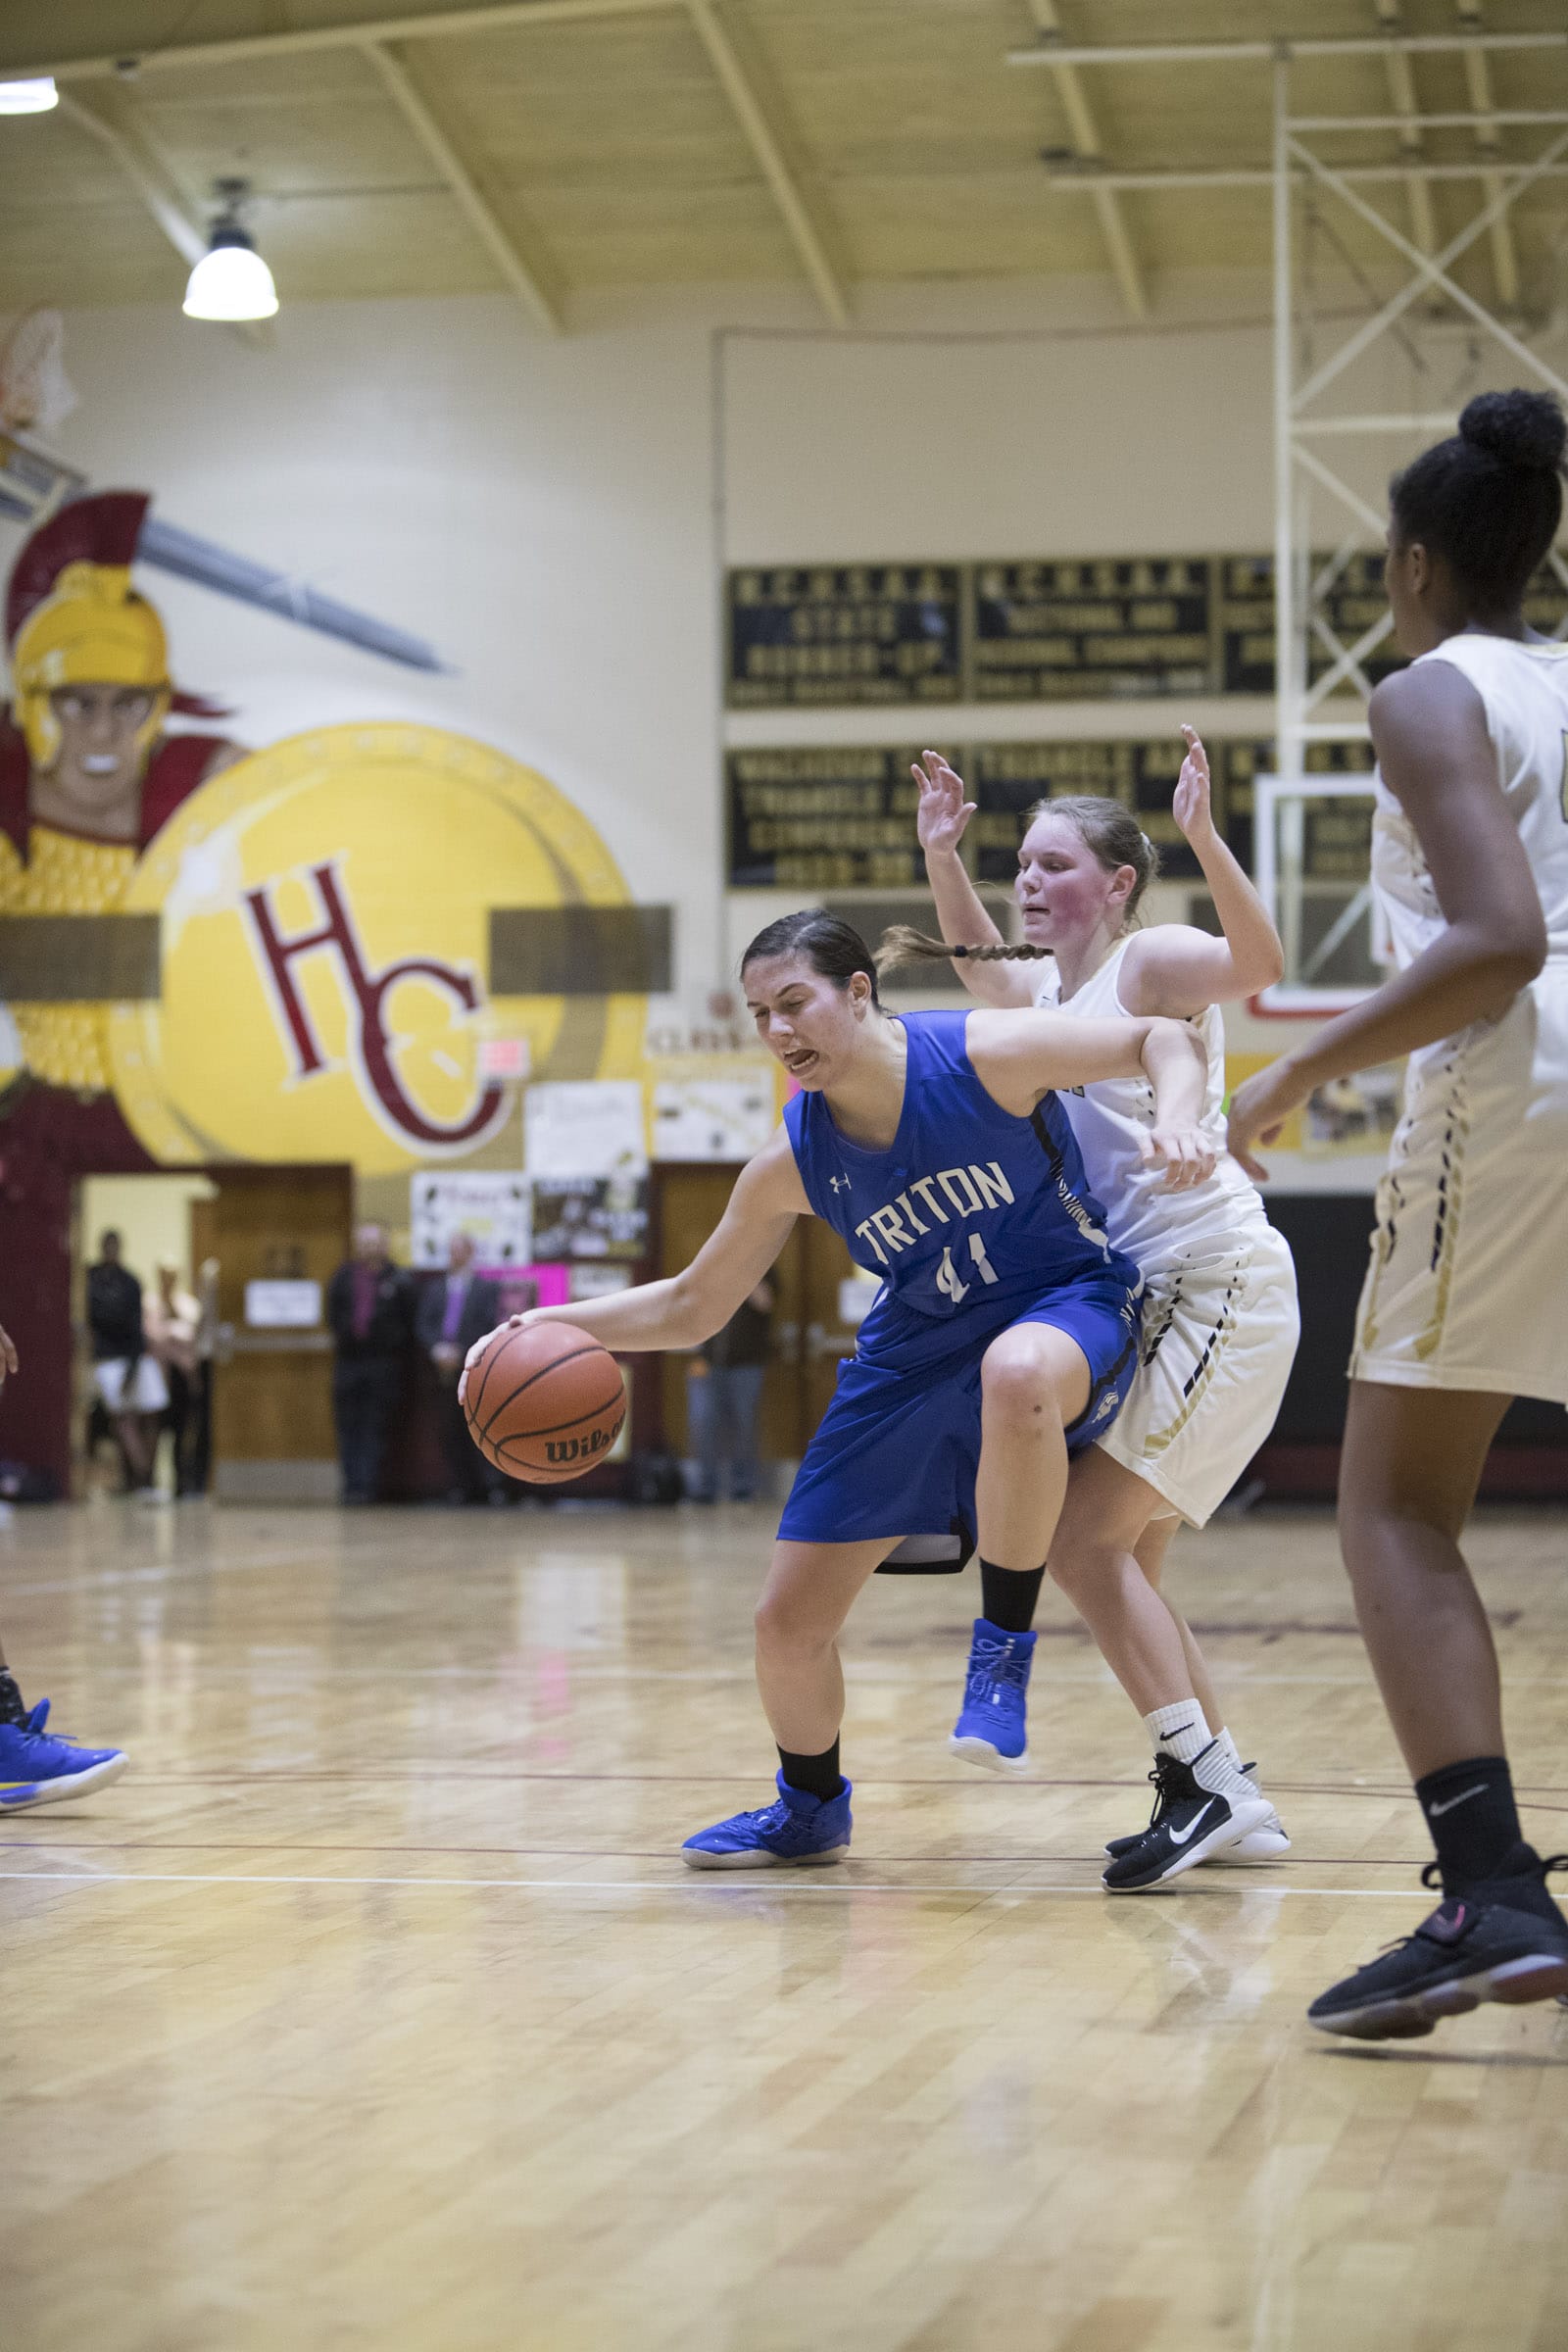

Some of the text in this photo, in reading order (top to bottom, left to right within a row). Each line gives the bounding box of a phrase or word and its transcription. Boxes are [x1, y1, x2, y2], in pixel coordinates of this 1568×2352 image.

[245, 856, 509, 1150] HC
[855, 1161, 1015, 1266] TRITON
[545, 1408, 626, 1463] Wilso
